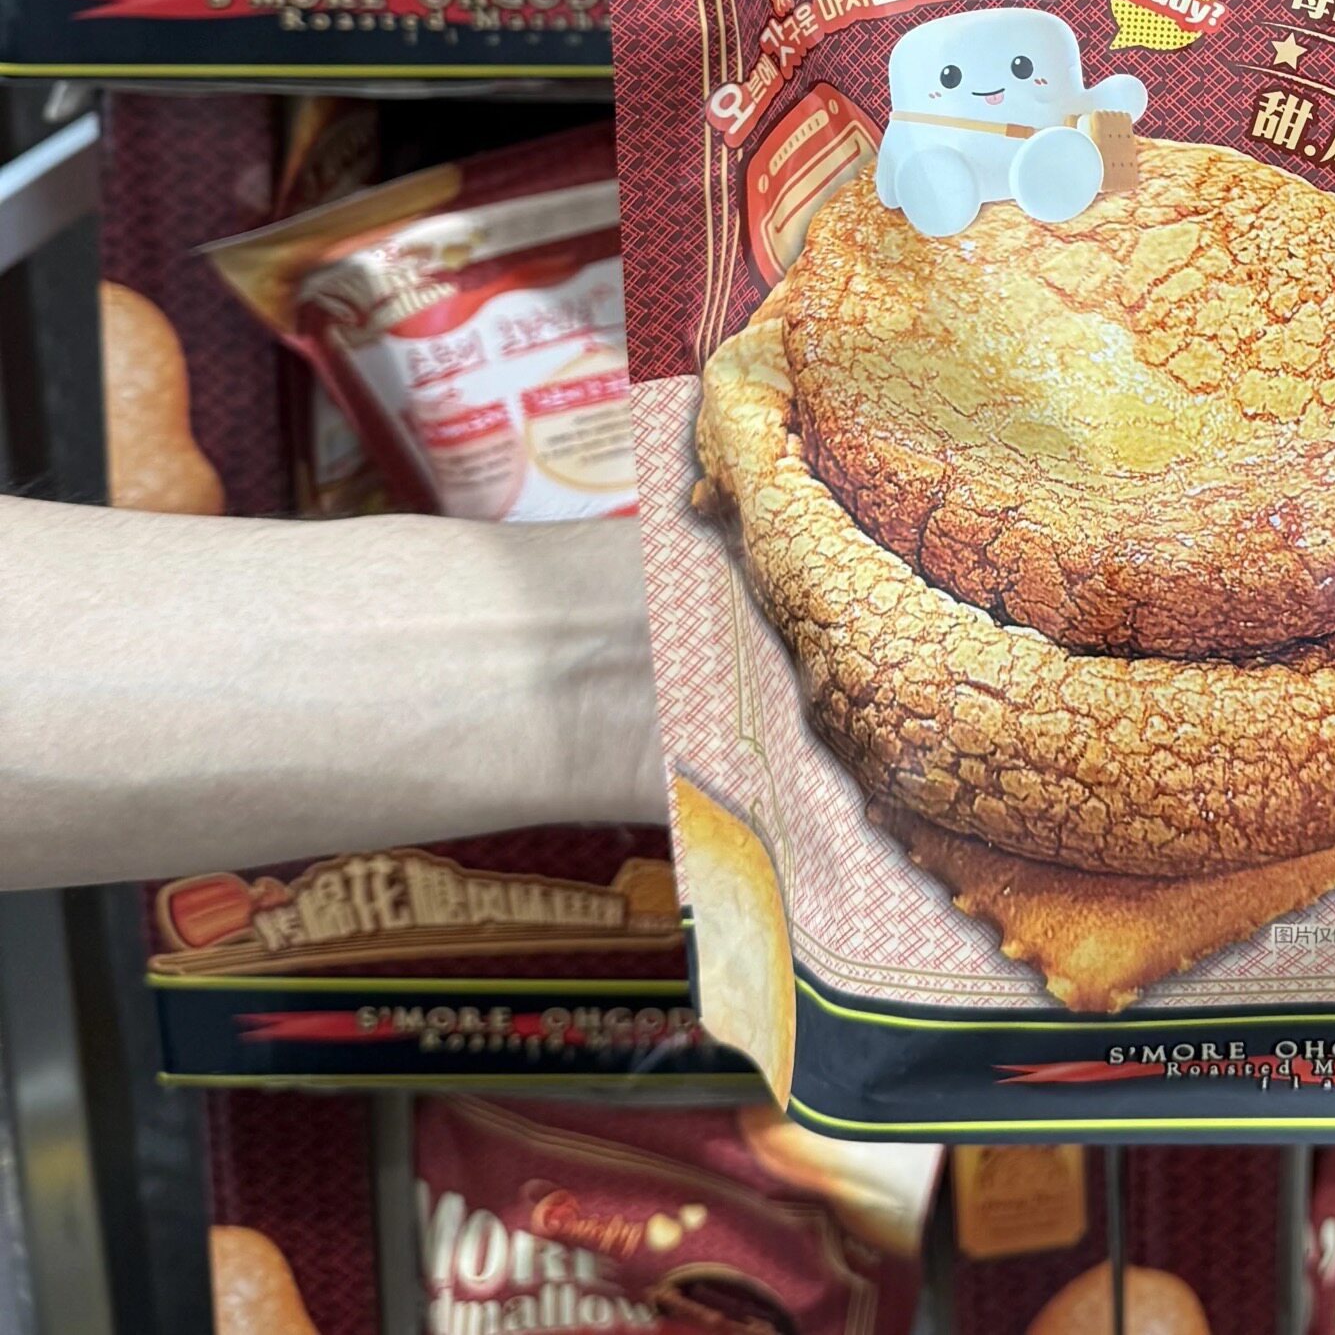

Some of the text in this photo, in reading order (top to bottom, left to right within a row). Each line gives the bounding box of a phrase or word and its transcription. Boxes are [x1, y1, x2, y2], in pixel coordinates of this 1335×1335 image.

[709, 55, 778, 136] 오븐에
[761, 2, 819, 67] 갓구운
[1109, 1040, 1246, 1066] S'MORE
[1165, 1060, 1291, 1077] Roasted
